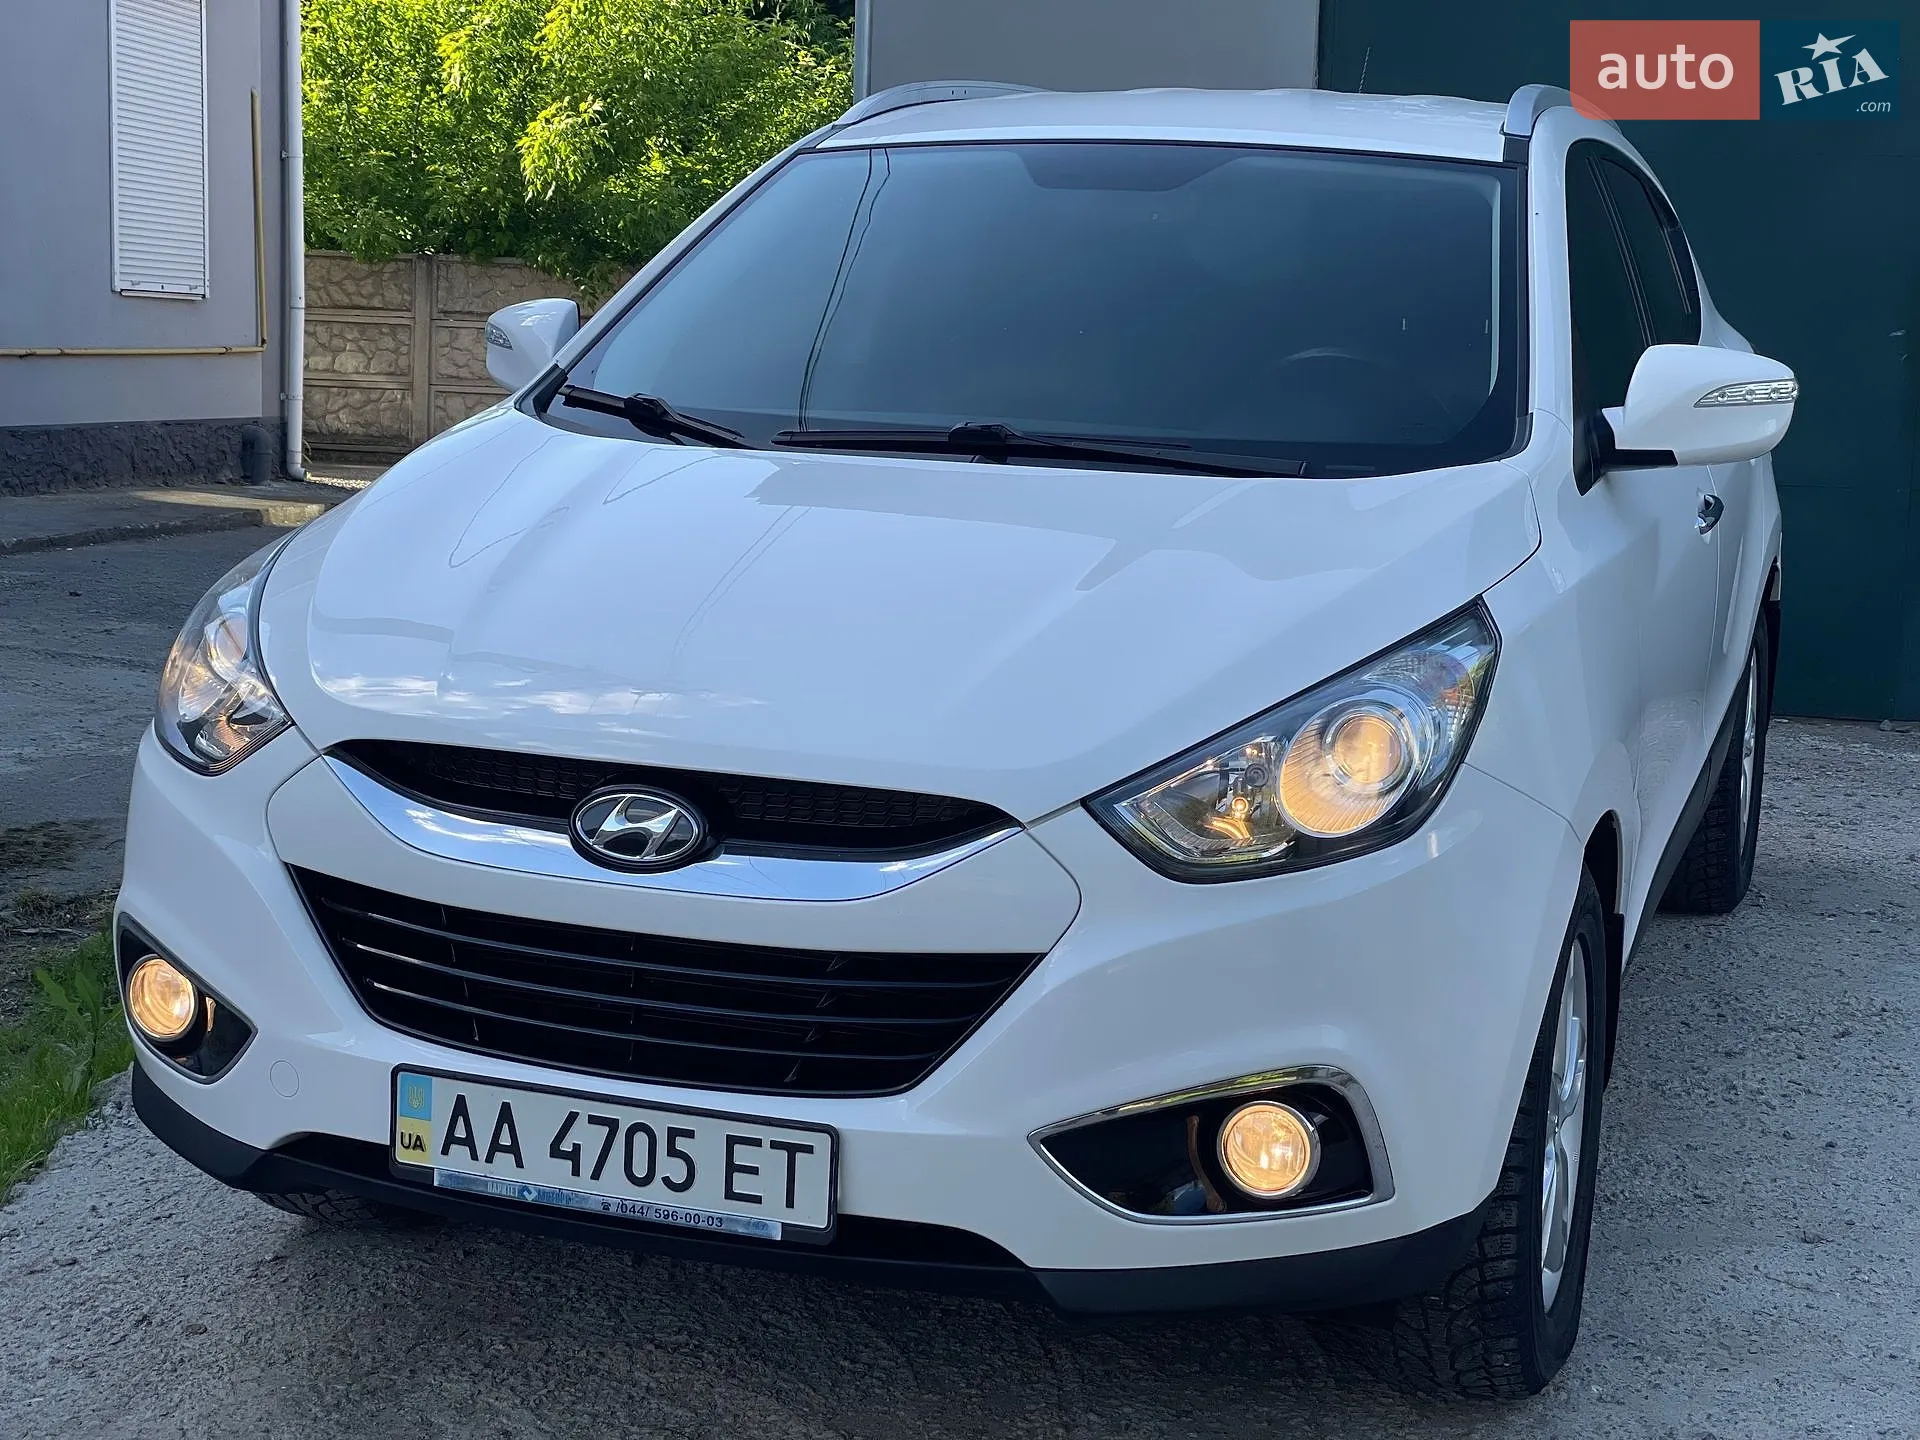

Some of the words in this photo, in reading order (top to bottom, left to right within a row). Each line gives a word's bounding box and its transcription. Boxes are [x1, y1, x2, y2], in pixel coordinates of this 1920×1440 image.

[400, 1131, 426, 1152] UA
[440, 1093, 525, 1169] AA
[549, 1110, 696, 1193] 4705
[723, 1133, 815, 1210] ET
[654, 1208, 724, 1228] 596-00-03
